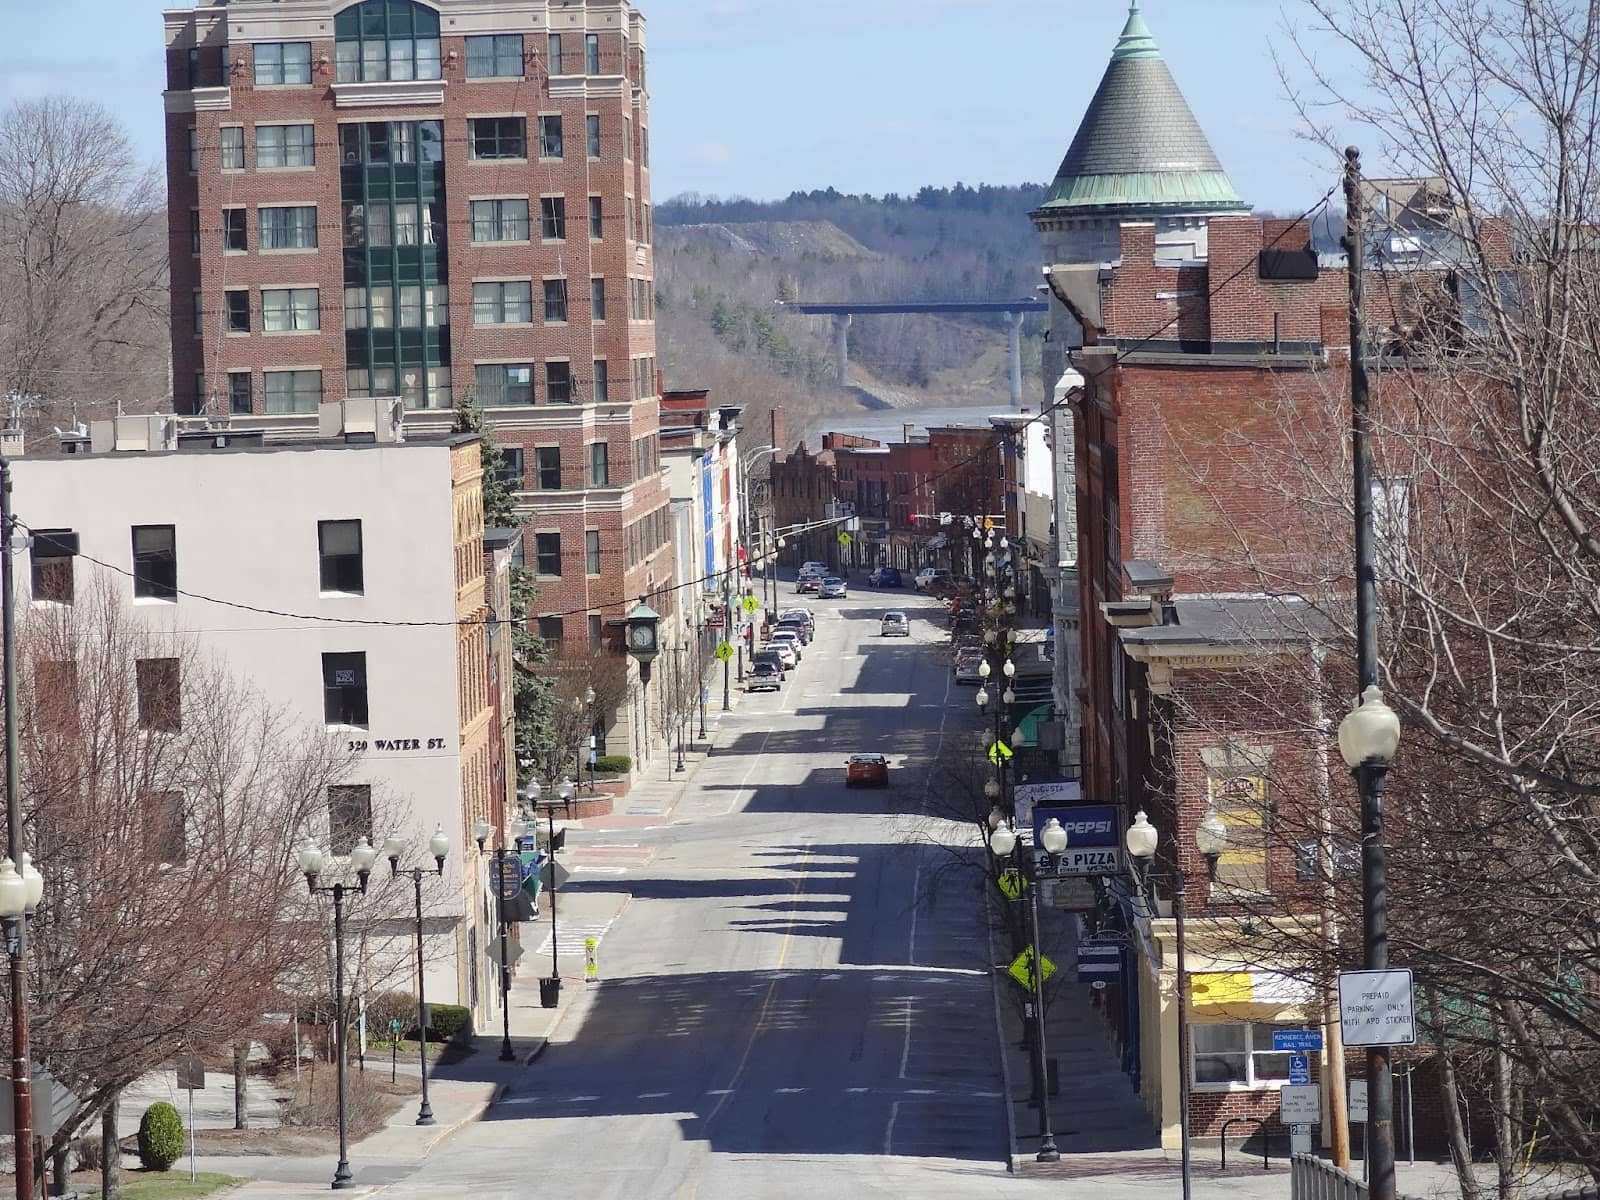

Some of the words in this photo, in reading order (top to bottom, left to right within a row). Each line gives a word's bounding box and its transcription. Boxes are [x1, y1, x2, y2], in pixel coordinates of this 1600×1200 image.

[348, 741, 368, 752] 320
[374, 739, 420, 751] WATER
[427, 738, 446, 749] ST.
[1064, 821, 1111, 834] PEPSI
[1074, 852, 1115, 865] PIZZA
[1362, 991, 1390, 1000] PREPAID
[1347, 1005, 1375, 1013] PARKING
[1387, 1003, 1404, 1012] ONLY
[1343, 1018, 1360, 1026] WITH
[1385, 1016, 1411, 1025] STICKER
[1291, 1125, 1297, 1135] 2
